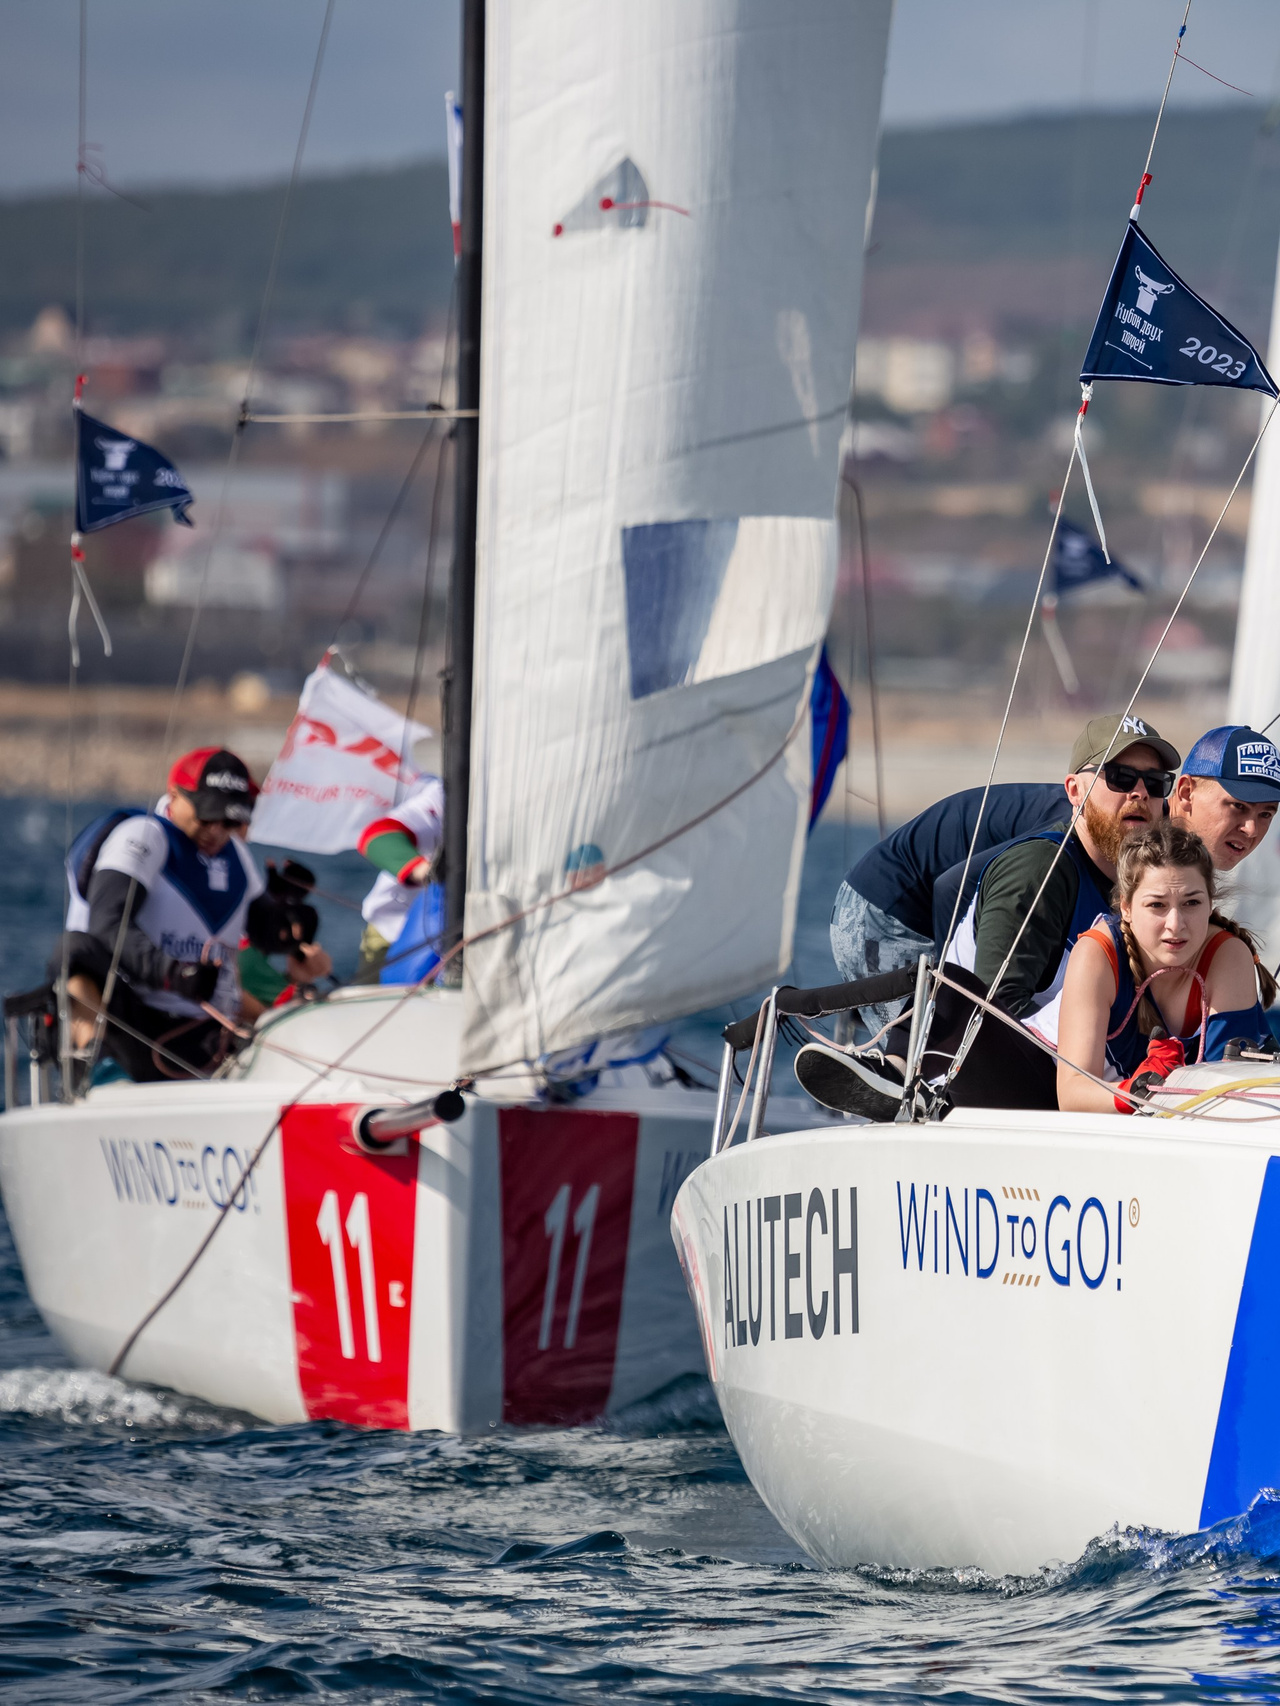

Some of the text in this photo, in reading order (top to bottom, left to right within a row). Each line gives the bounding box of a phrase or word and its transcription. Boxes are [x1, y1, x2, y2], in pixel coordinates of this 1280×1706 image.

[1114, 301, 1164, 342] Кубок двух
[1178, 336, 1247, 380] 2023
[1123, 716, 1147, 736] NY
[316, 1189, 382, 1363] 11
[537, 1183, 600, 1351] 11
[724, 1186, 859, 1350] ALUTECH
